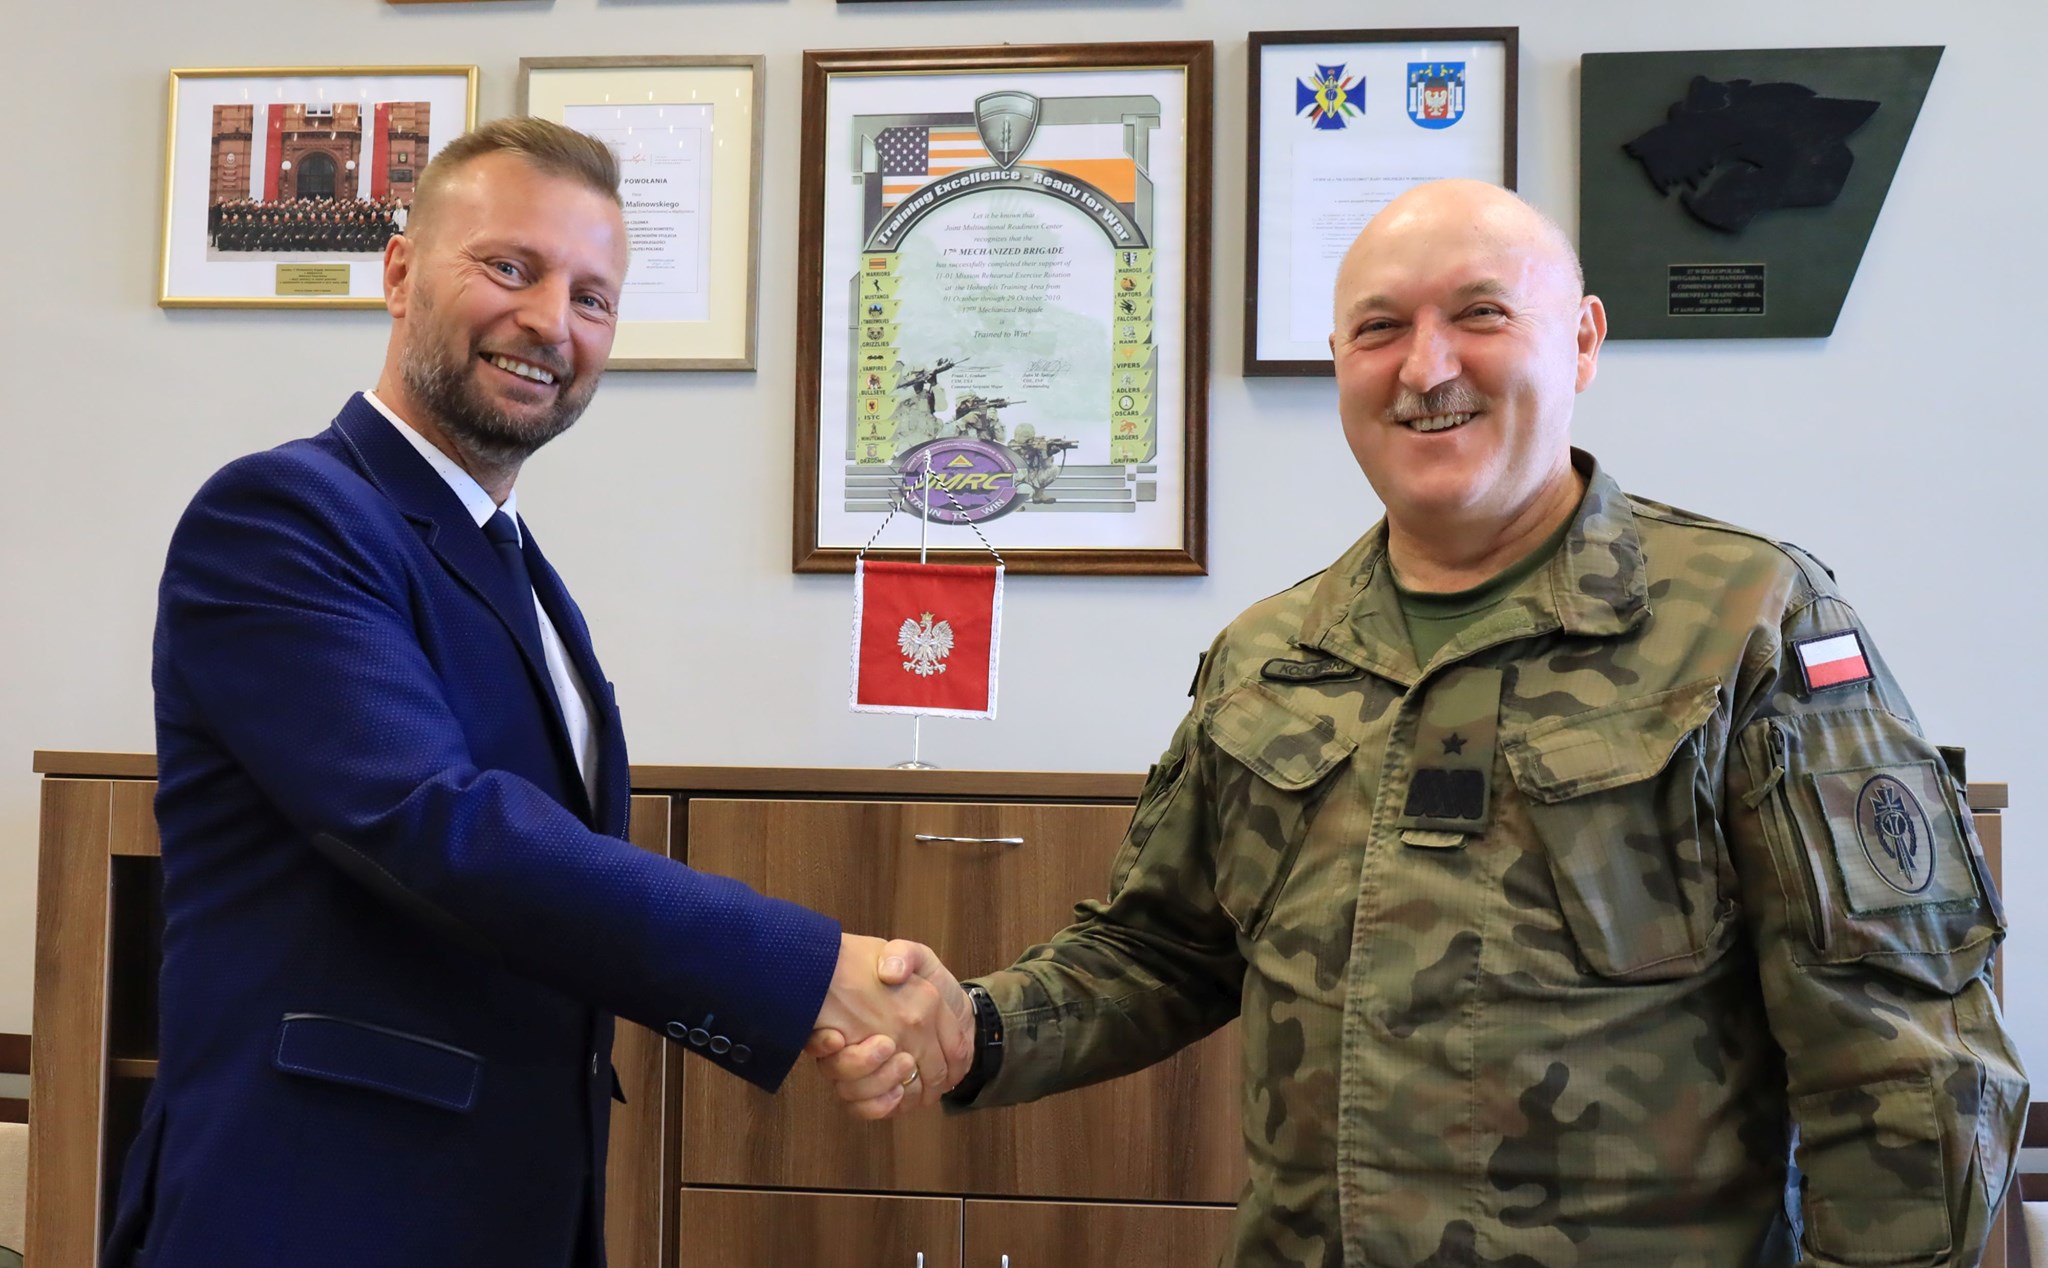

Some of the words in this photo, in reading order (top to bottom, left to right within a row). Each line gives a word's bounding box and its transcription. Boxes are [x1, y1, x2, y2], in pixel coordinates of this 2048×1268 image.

[625, 201, 680, 209] Malinowskiego
[876, 191, 934, 244] Training
[934, 170, 1020, 196] Excellence
[1032, 172, 1081, 198] Ready
[1080, 192, 1103, 212] for
[1102, 208, 1130, 240] War
[963, 223, 1005, 231] Multinational
[959, 247, 1021, 255] MECHANIZED
[949, 260, 985, 269] successfully
[988, 260, 1020, 268] completed
[1039, 260, 1062, 268] support
[1018, 306, 1043, 314] Brigade
[973, 330, 1002, 338] Trained
[981, 499, 1005, 514] WIN
[1885, 814, 1900, 835] 17
